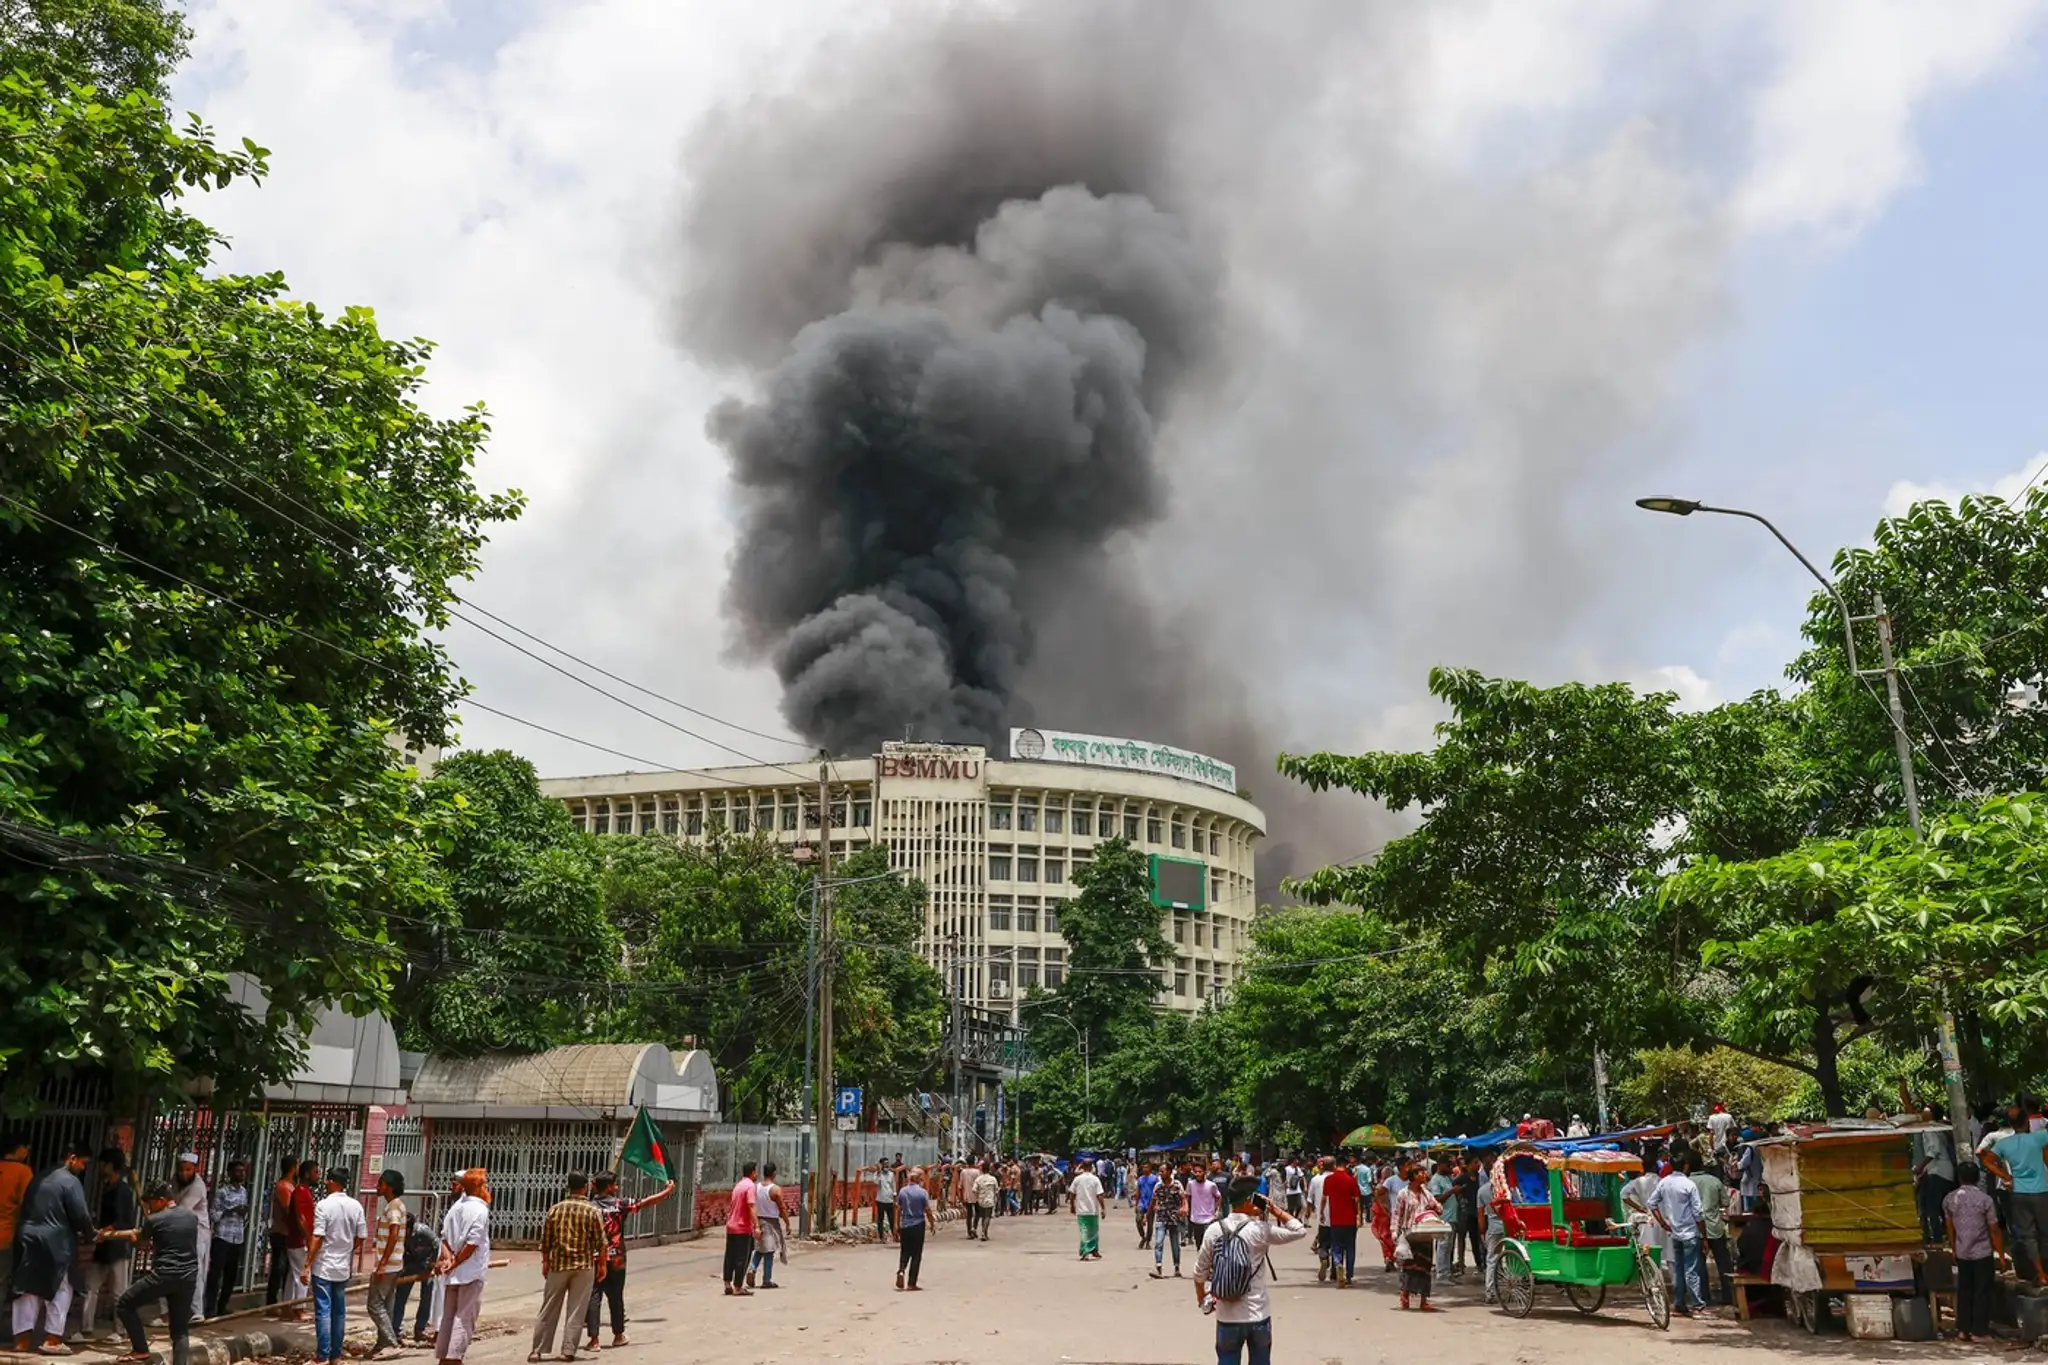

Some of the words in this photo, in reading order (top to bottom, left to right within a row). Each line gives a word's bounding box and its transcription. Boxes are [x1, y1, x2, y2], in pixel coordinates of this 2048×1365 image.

[1052, 738, 1088, 764] বঙ্গবন্ধু
[1090, 742, 1115, 761] শেখ
[1117, 741, 1149, 767] মুজিব
[880, 757, 979, 780] BSMMU
[841, 1091, 855, 1110] P
